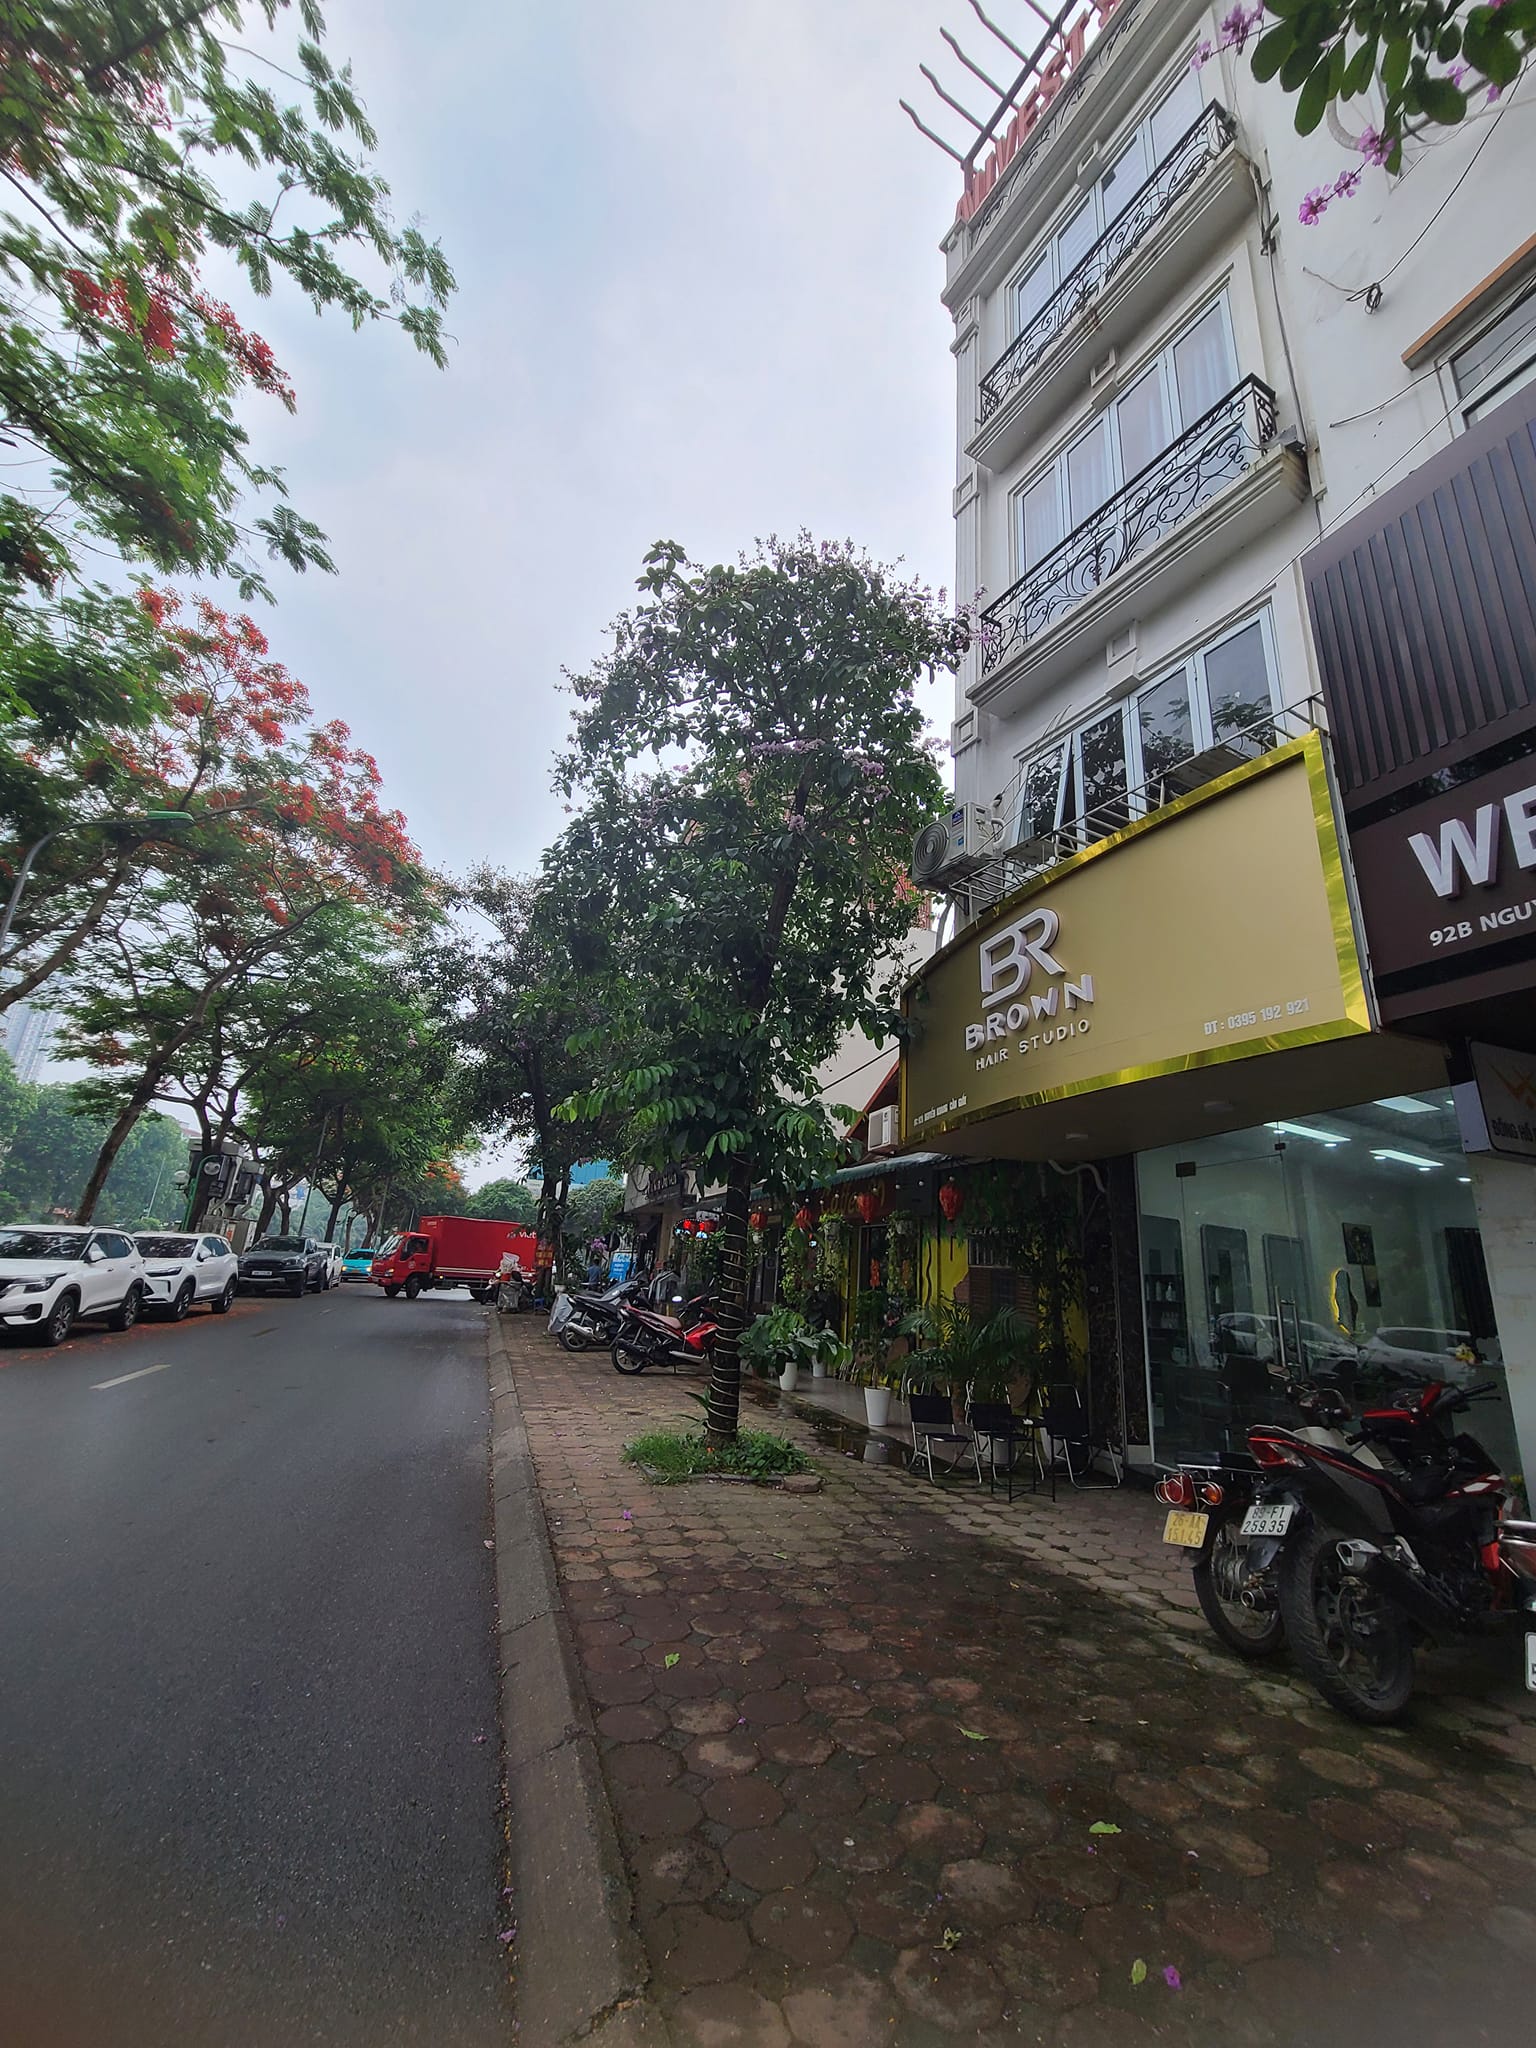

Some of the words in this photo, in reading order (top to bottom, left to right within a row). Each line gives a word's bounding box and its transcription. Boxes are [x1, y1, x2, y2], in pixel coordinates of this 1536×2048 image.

[1429, 921, 1473, 947] 92B
[980, 907, 1067, 1009] BR
[965, 973, 1095, 1051] BROWN
[1227, 1011, 1257, 1029] 0395
[1260, 1005, 1282, 1021] 192
[1286, 998, 1309, 1016] 921
[976, 1048, 1009, 1071] HAIR
[1018, 1019, 1090, 1054] STUDIO
[1243, 1520, 1286, 1533] 259.35
